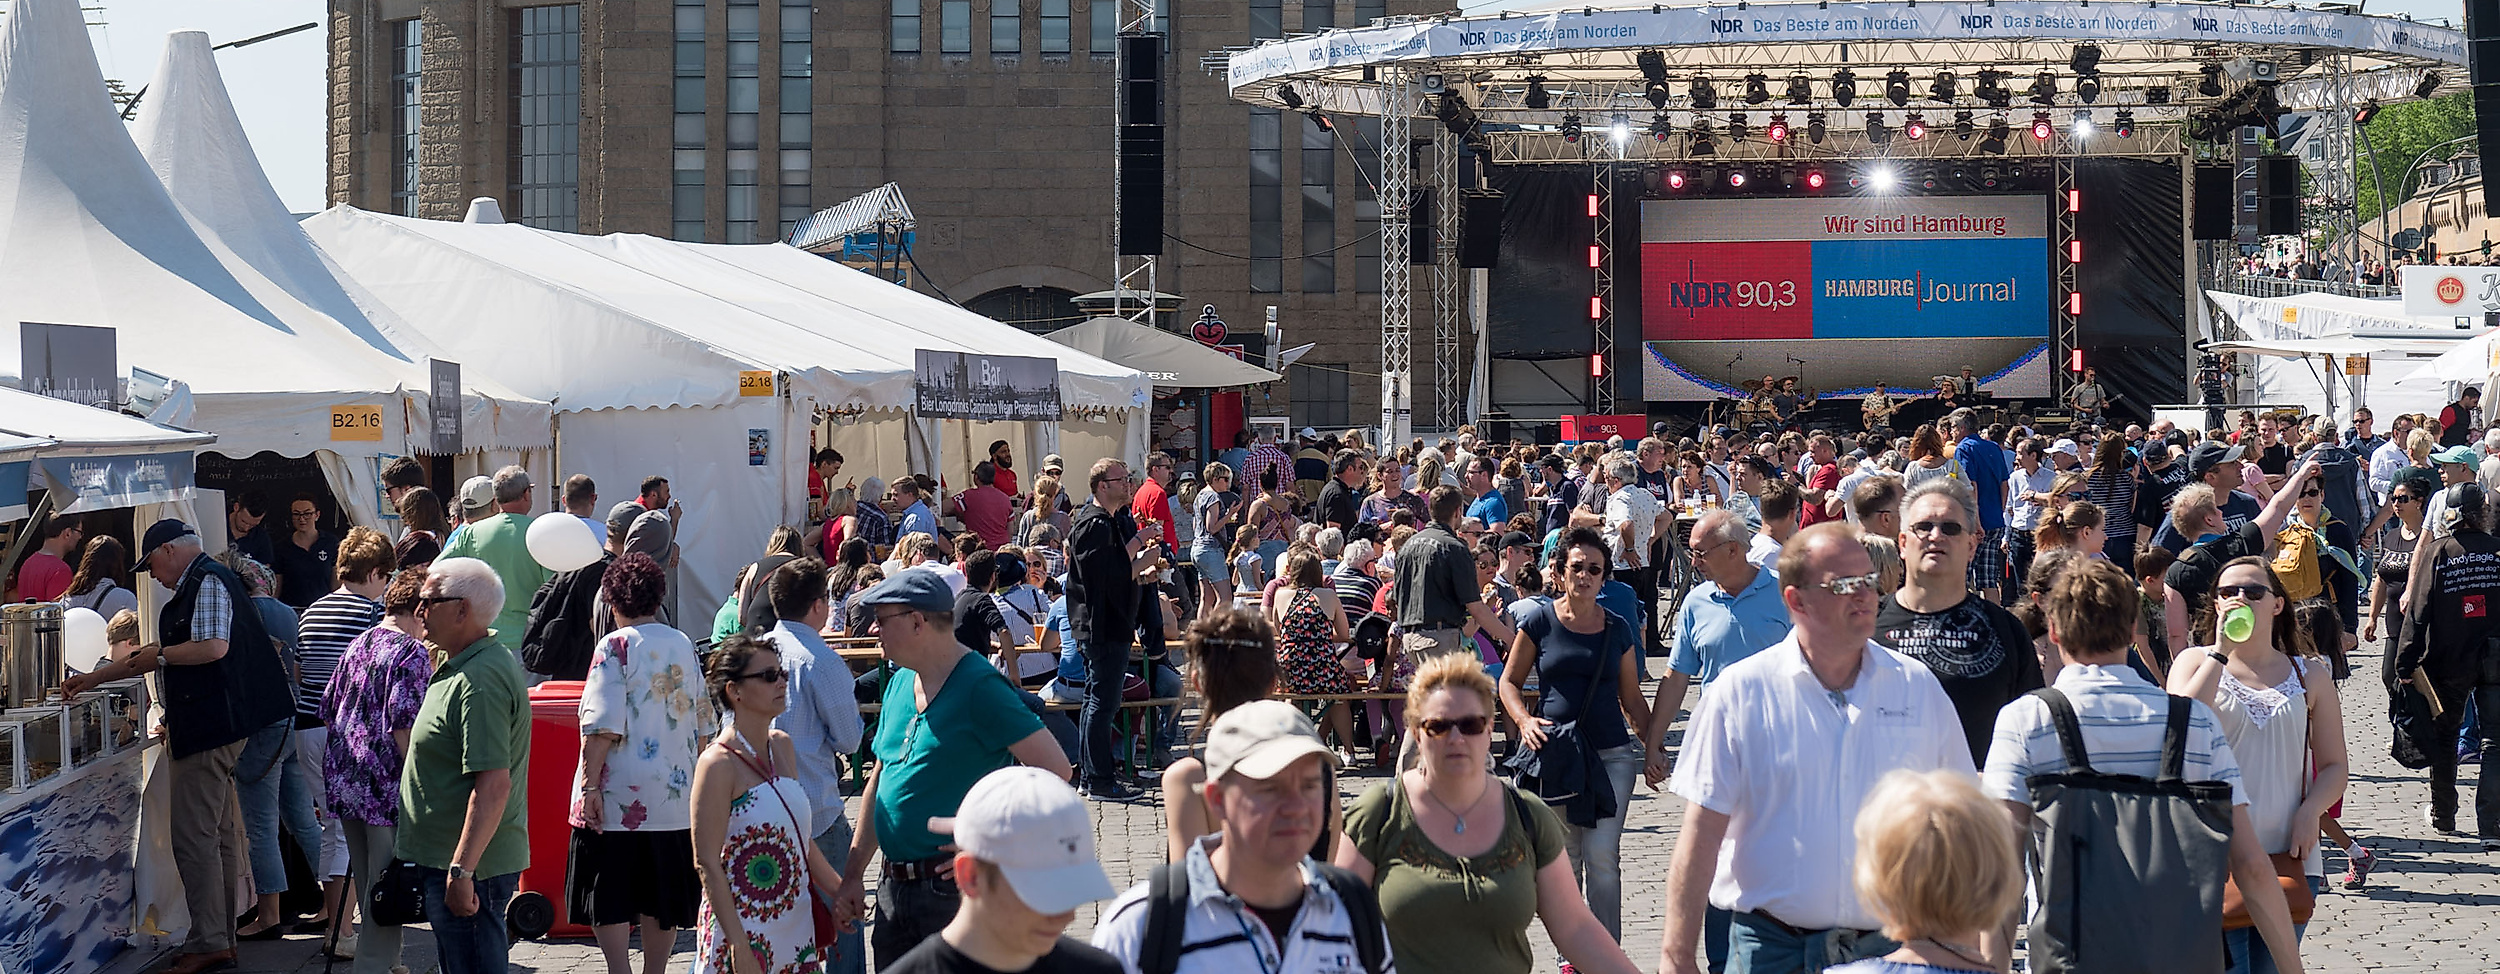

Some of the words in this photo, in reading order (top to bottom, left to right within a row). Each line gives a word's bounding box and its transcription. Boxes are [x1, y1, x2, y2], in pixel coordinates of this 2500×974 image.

[1711, 19, 1743, 34] NDR
[1753, 19, 1781, 33] Das
[1786, 18, 1830, 31] Beste
[1835, 19, 1857, 31] am
[1863, 16, 1919, 31] Norden
[1961, 15, 1993, 29] NDR
[2003, 15, 2031, 28] Das
[2035, 14, 2075, 29] Beste
[2079, 17, 2100, 29] am
[2105, 16, 2157, 30] Norden
[2193, 18, 2218, 32] NDR
[2226, 20, 2247, 34] Das
[2251, 21, 2286, 36] Beste
[2290, 24, 2308, 36] am
[2309, 23, 2343, 40] Norden
[1460, 32, 1486, 46] NDR
[1494, 31, 1516, 44] Das
[1520, 28, 1554, 42] Beste
[1557, 27, 1579, 39] am
[1584, 24, 1637, 38] Norden
[2392, 31, 2408, 46] NDR
[1308, 48, 1323, 62] NDR
[1344, 42, 1372, 57] Beste
[1374, 42, 1388, 53] am
[1392, 37, 1428, 52] Norden
[1823, 214, 1859, 234] Wir
[1863, 214, 1906, 234] sind
[1911, 213, 2006, 236] Hamburg
[1669, 281, 1733, 308] NDR
[1736, 280, 1797, 311] 90,3
[1824, 279, 1914, 298] HAMBURG
[1922, 277, 2017, 303] Journal
[740, 376, 771, 388] B2.18
[981, 358, 1001, 386] Bar
[921, 395, 934, 411] Bier
[935, 396, 969, 416] Longdrinks
[970, 398, 997, 416] Caipirinha
[1014, 400, 1038, 415] Prosecco
[1044, 401, 1060, 416] Kaffee
[333, 413, 379, 427] B2.16
[1600, 424, 1618, 434] 90,3
[2447, 553, 2494, 567] AndyEagle
